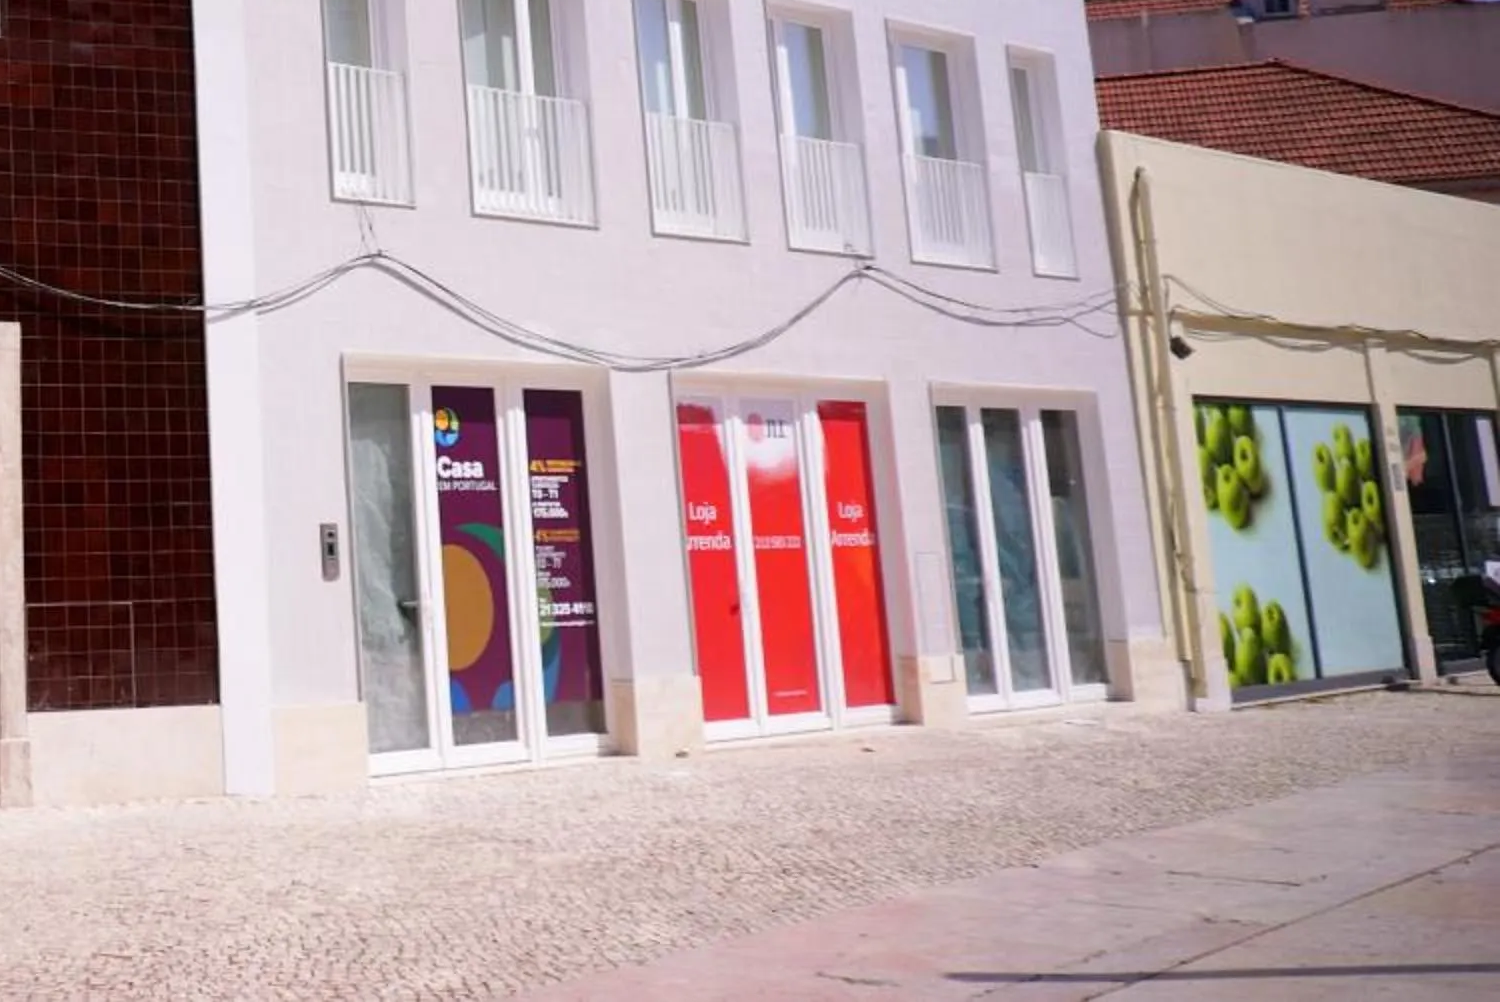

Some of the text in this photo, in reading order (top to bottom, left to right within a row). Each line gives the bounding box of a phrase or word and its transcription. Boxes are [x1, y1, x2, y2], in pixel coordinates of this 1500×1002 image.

[437, 455, 485, 479] Casa
[452, 480, 498, 492] PORTUGAL
[688, 502, 717, 524] Loja
[837, 501, 864, 523] Loja
